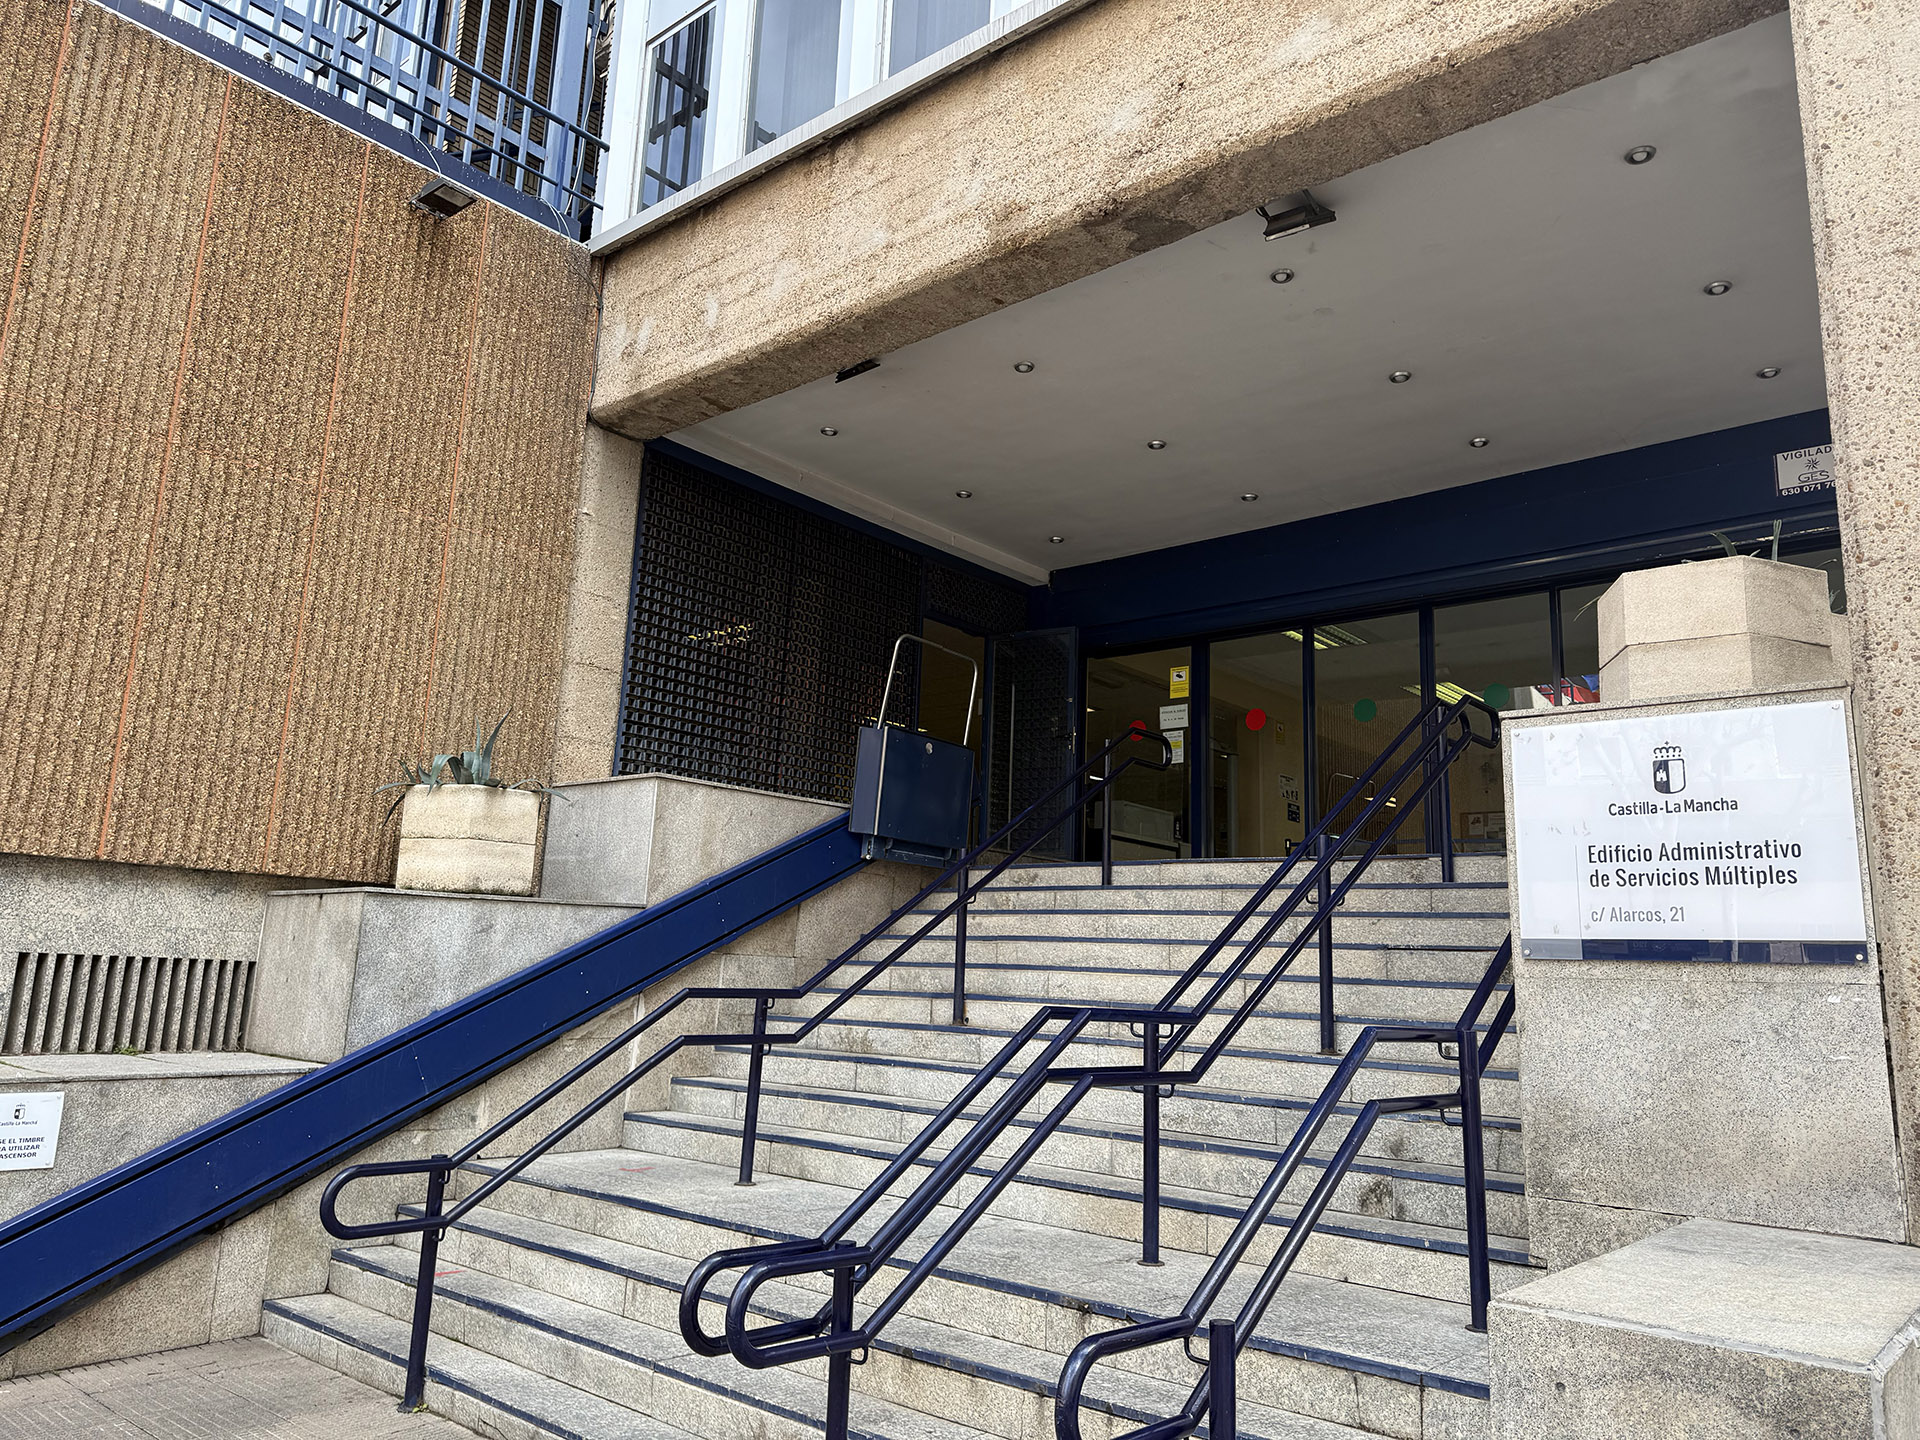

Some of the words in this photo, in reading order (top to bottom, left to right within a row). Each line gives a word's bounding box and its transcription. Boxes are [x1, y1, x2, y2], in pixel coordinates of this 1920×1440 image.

[1797, 470, 1830, 484] GES
[1782, 487, 1800, 496] 630
[1803, 484, 1821, 492] 071
[1683, 797, 1738, 813] Mancha
[1588, 844, 1653, 864] Edificio
[1659, 839, 1802, 862] Administrativo
[1589, 869, 1610, 887] de
[1615, 868, 1699, 887] Servicios
[1705, 865, 1798, 888] Múltiples
[1591, 907, 1605, 922] c/
[1609, 906, 1666, 924] Alarcos,
[1670, 906, 1685, 922] 21
